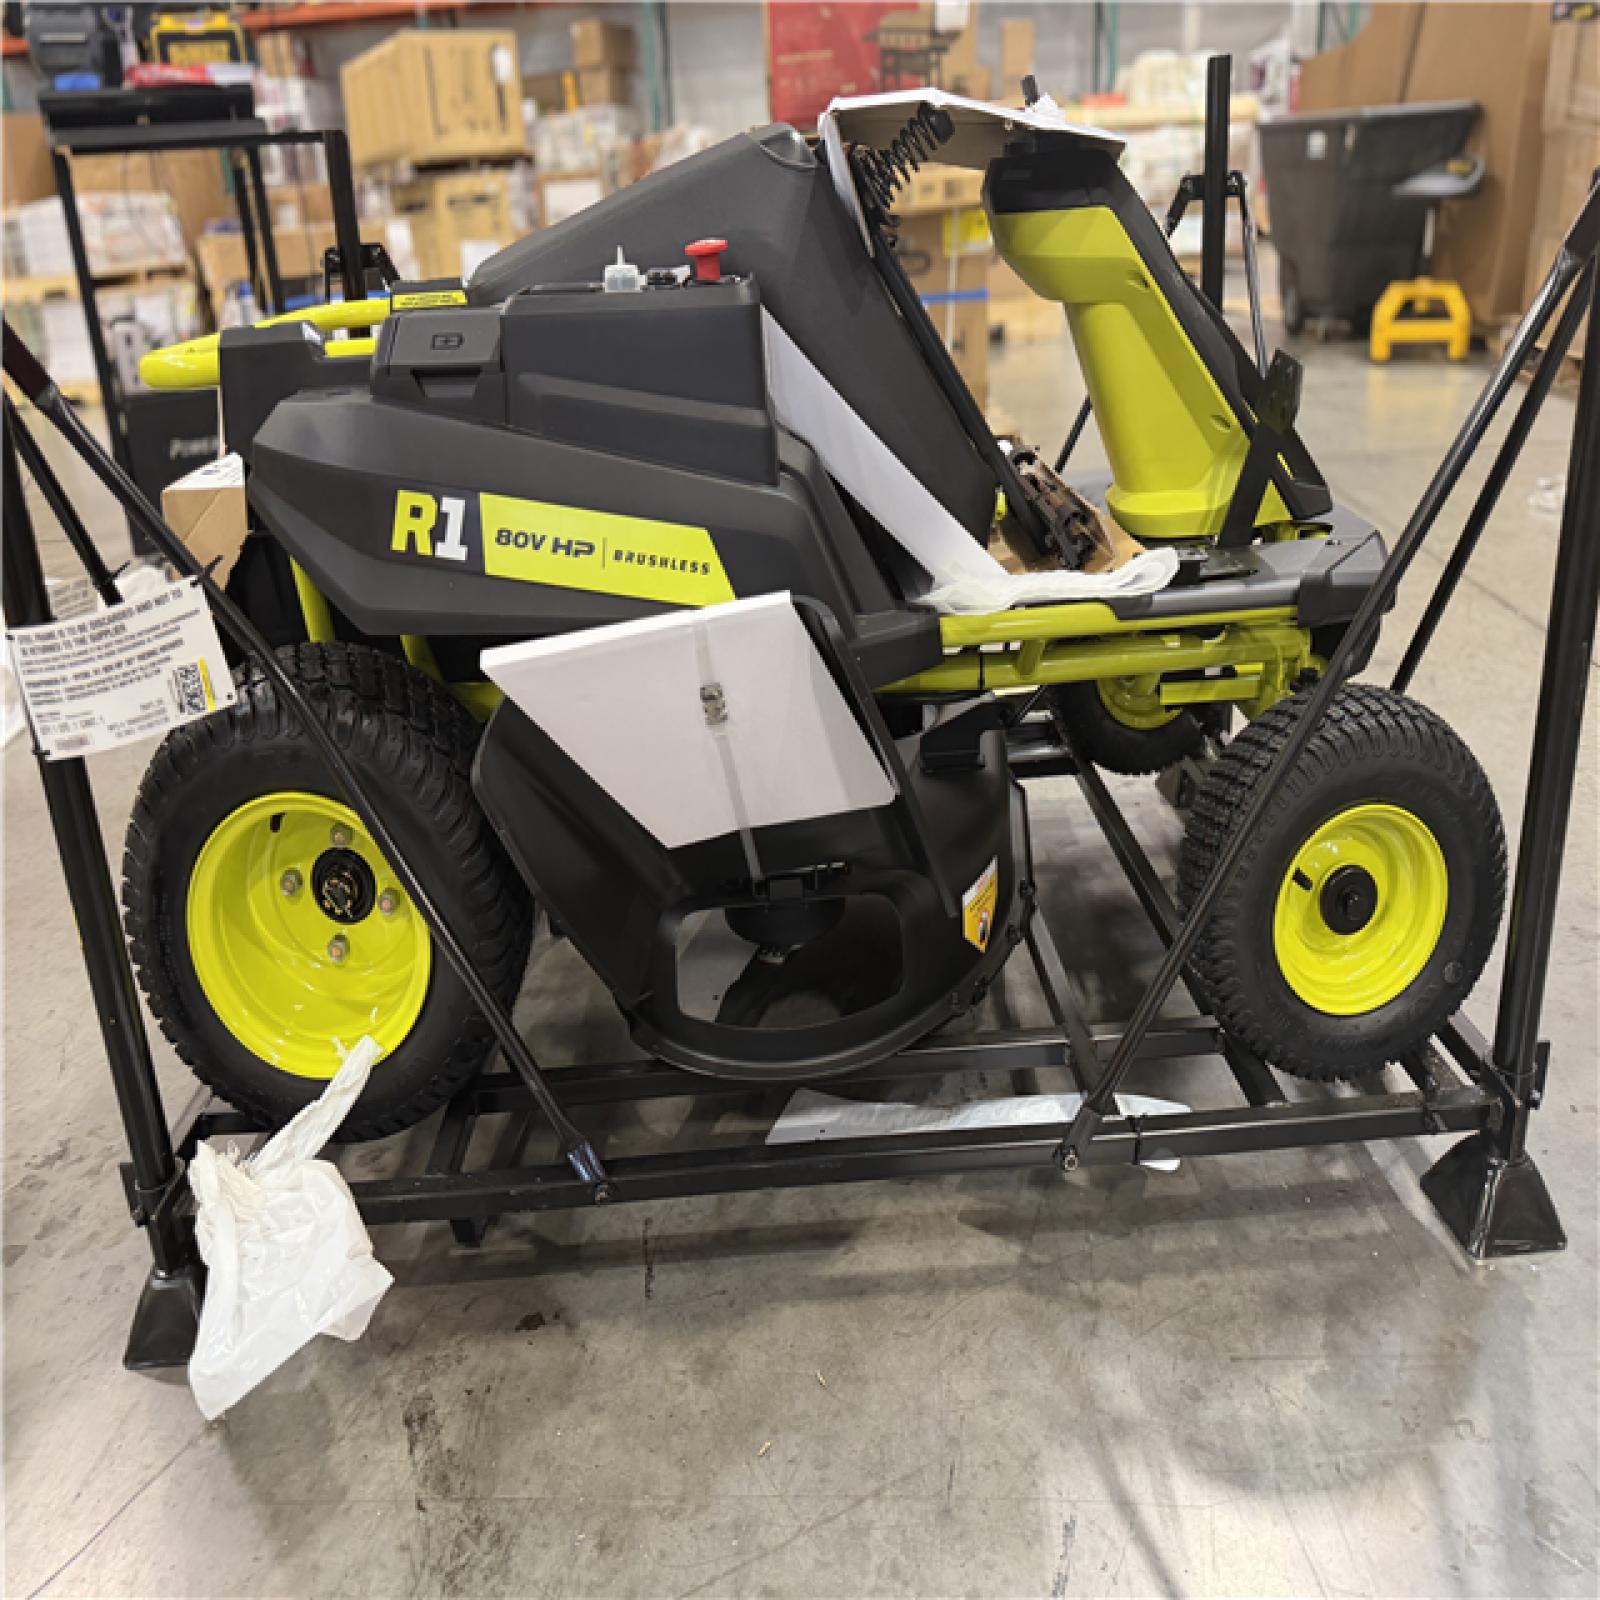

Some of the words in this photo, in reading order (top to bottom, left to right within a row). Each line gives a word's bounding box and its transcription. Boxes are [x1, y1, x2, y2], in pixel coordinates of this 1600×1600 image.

[391, 489, 468, 561] R1
[495, 528, 547, 551] 80V
[551, 536, 595, 558] HP
[613, 548, 711, 576] BRUSHLESS
